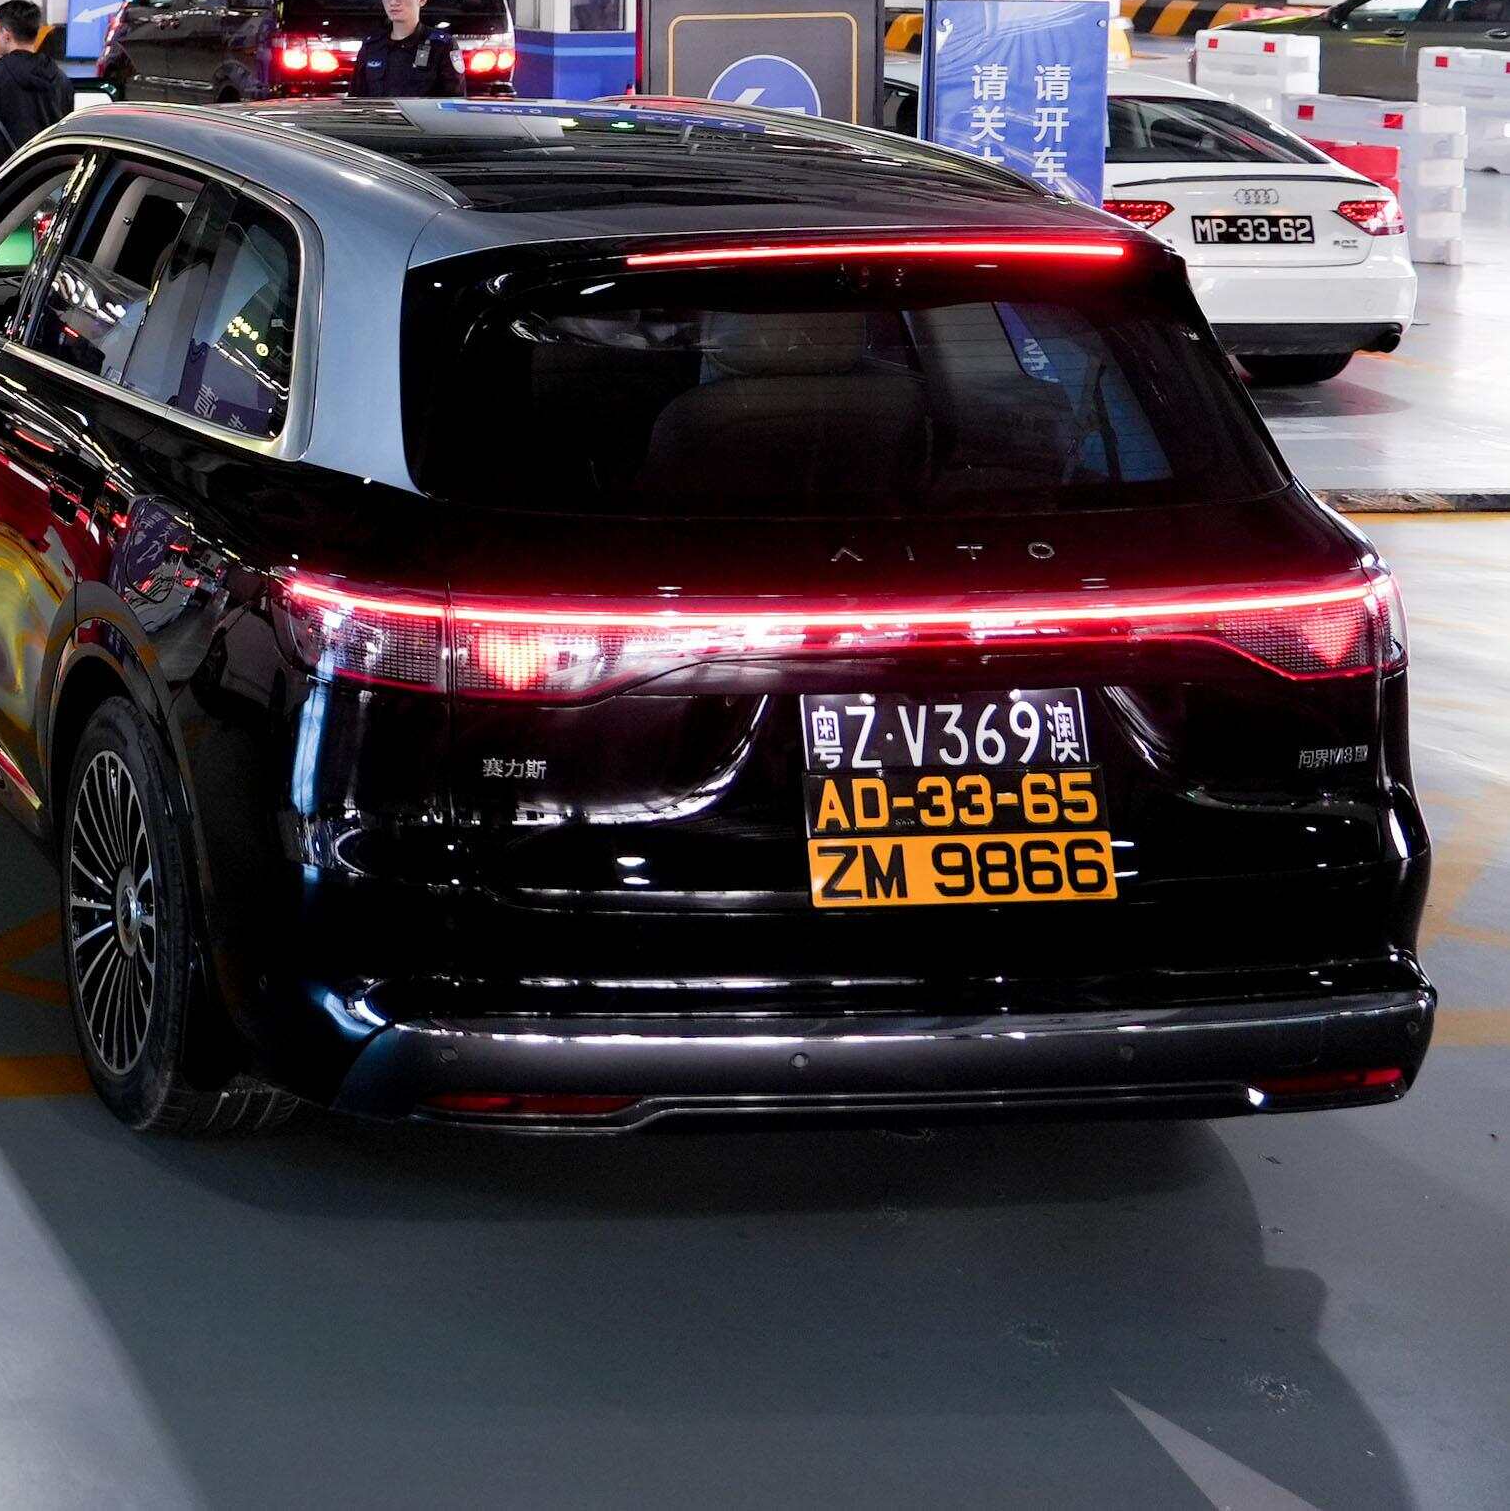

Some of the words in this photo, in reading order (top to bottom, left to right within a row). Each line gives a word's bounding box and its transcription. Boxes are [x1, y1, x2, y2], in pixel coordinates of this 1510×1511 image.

[1031, 63, 1072, 185] 请开车
[1194, 218, 1314, 244] MP-33-62
[482, 757, 548, 779] 赛力斯
[814, 771, 1099, 833] AD-33-65
[816, 843, 908, 901] ZM
[931, 838, 1109, 897] 9866
